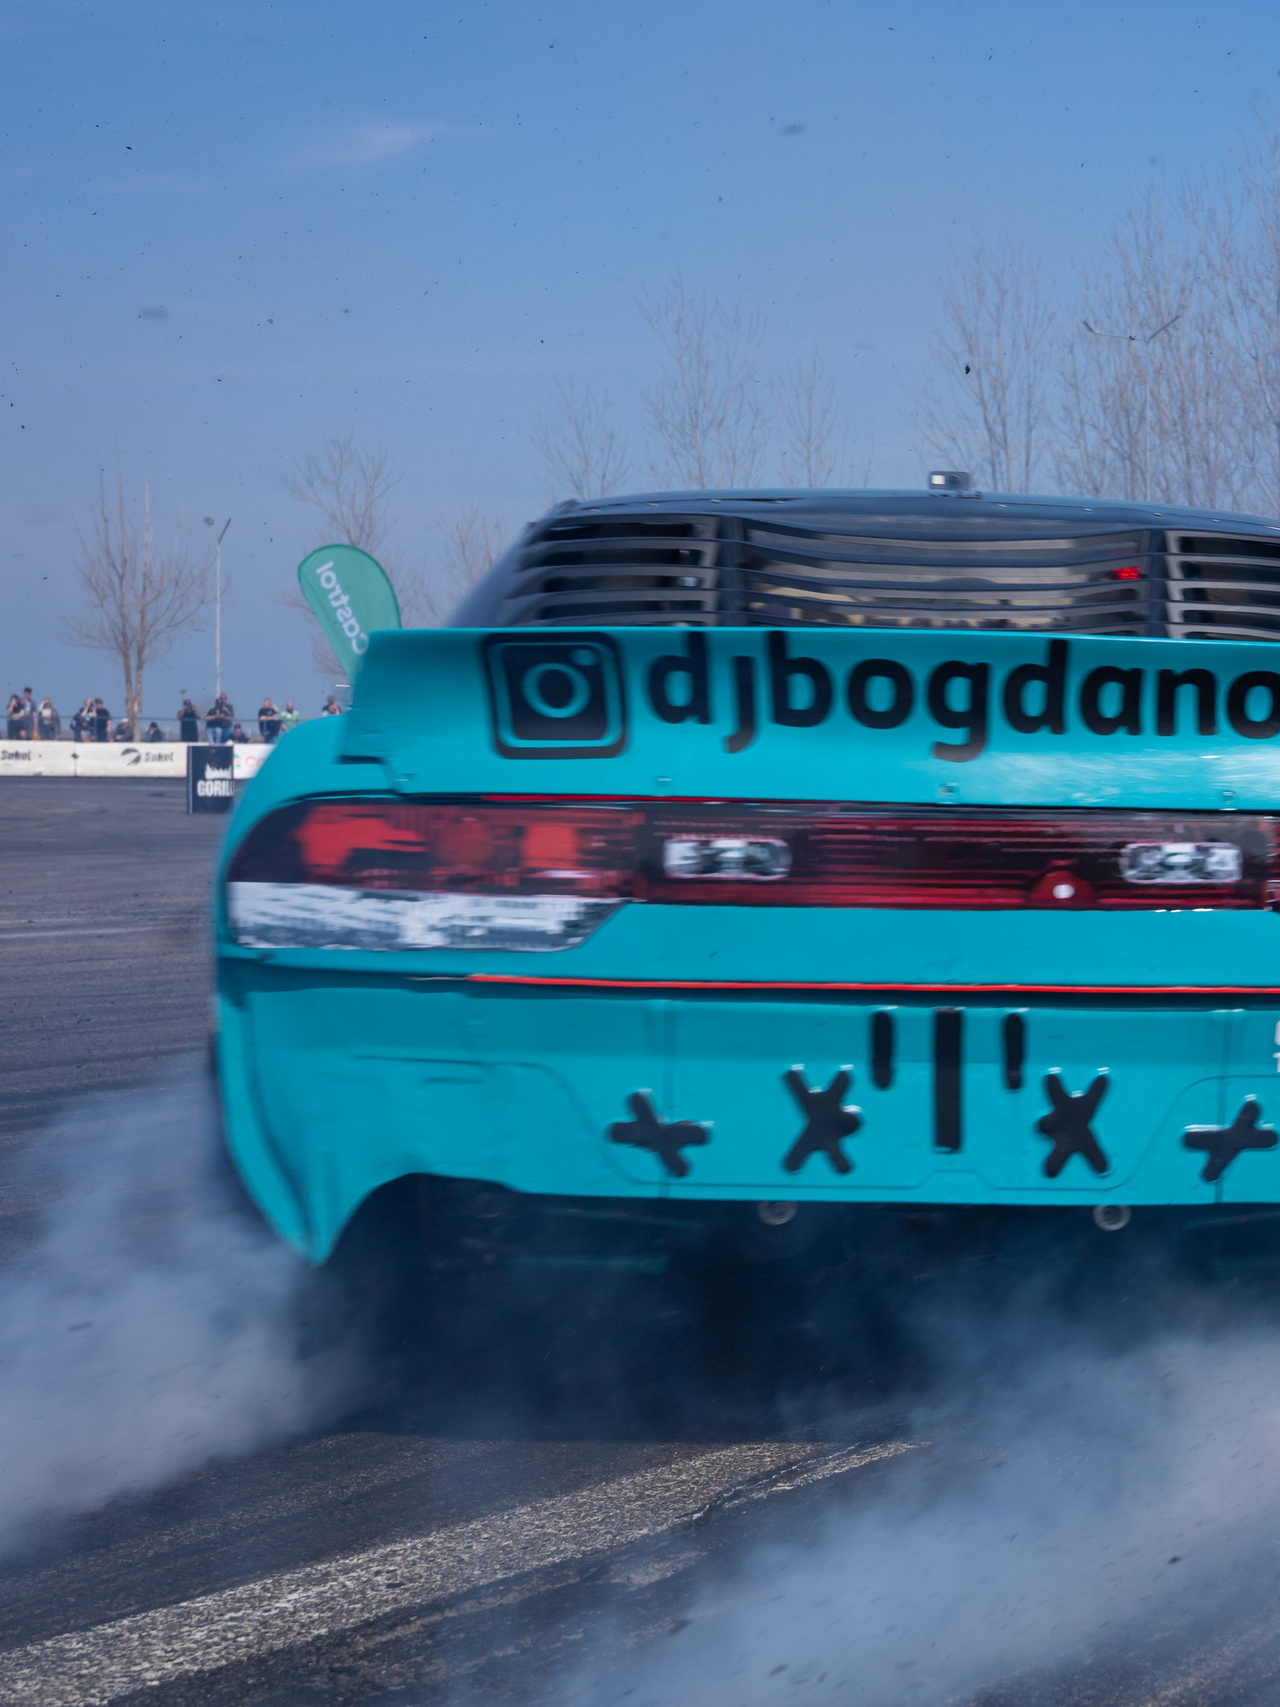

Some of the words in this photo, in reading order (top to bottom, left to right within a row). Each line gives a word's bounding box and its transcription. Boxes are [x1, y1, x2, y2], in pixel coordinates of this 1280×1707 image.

[1, 749, 31, 762] Sokol
[145, 750, 175, 763] Sokol
[197, 779, 235, 797] GORILL
